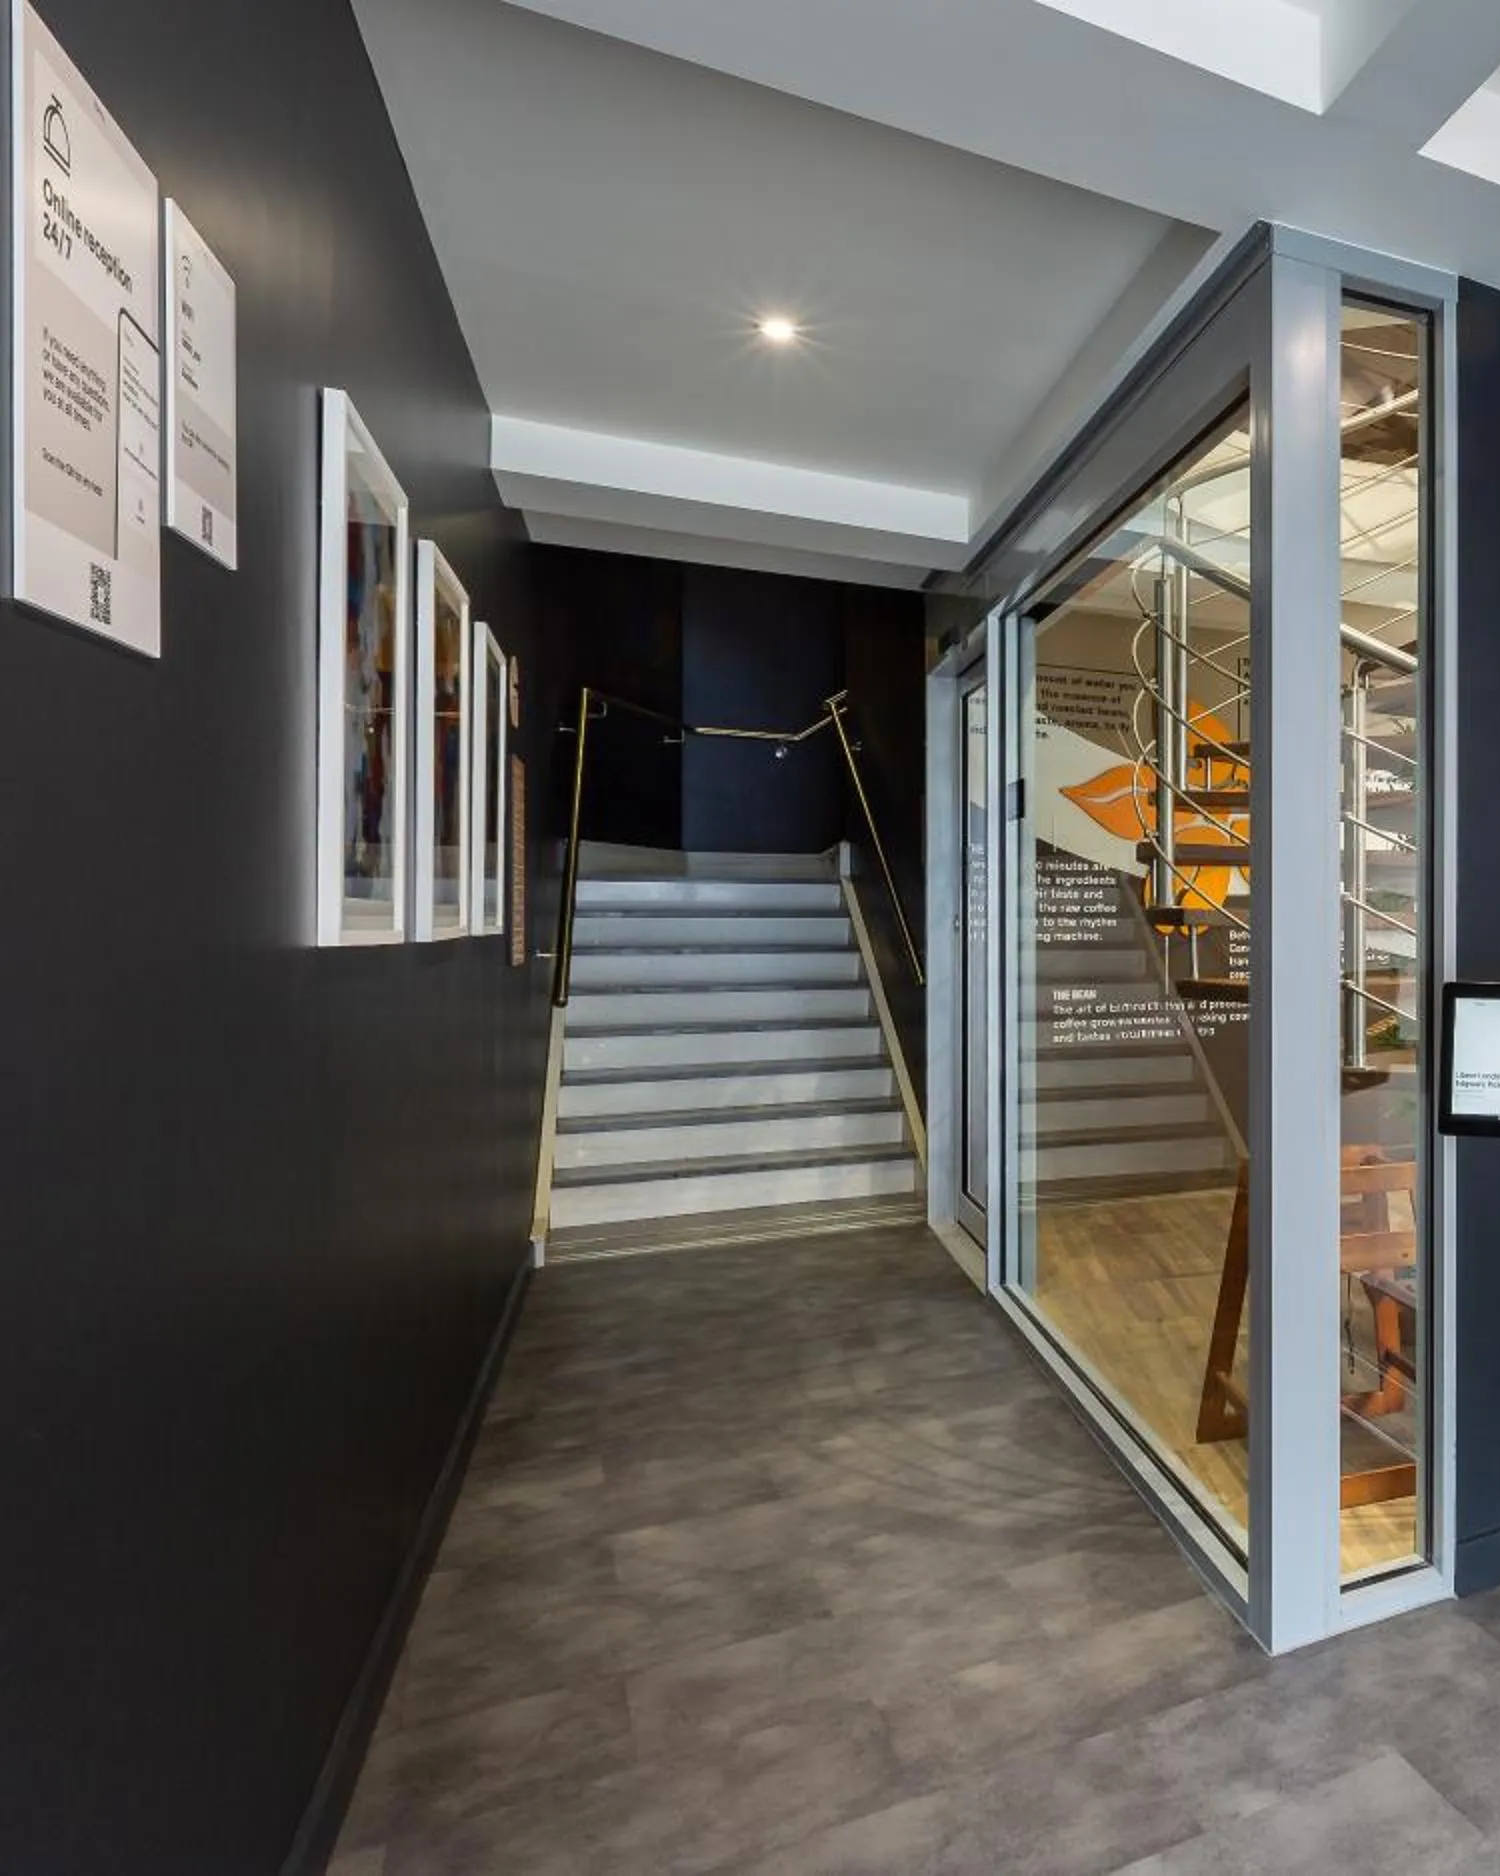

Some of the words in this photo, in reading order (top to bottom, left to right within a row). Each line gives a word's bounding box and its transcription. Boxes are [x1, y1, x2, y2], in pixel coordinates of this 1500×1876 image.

[43, 211, 72, 259] 24/7
[43, 178, 81, 238] Online
[83, 225, 132, 293] reception
[1083, 889, 1103, 899] and
[1083, 903, 1117, 913] coffee
[1053, 1005, 1073, 1014] The
[1053, 1034, 1073, 1044] and
